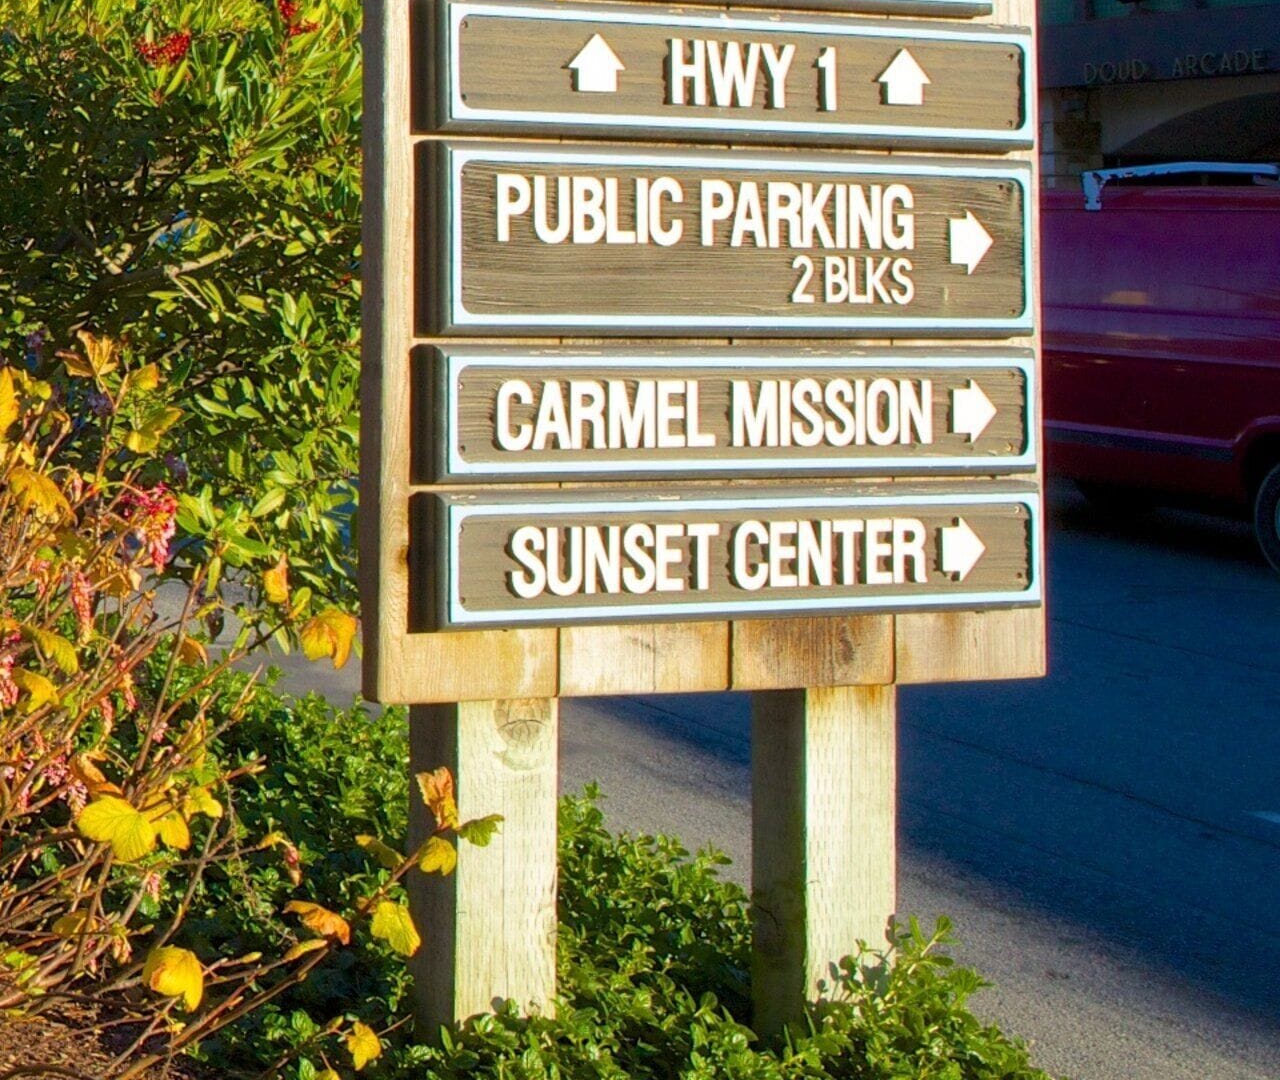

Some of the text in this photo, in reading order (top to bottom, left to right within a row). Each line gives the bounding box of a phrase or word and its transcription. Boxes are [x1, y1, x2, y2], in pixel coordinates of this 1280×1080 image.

[672, 39, 838, 111] HWY 1
[1083, 49, 1266, 84] DOUD ARCADE
[497, 174, 915, 250] PUBLIC PARKING
[792, 256, 914, 305] 2 BLKS
[497, 379, 933, 451] CARMEL MISSION
[511, 519, 927, 599] SUNSET CENTER
